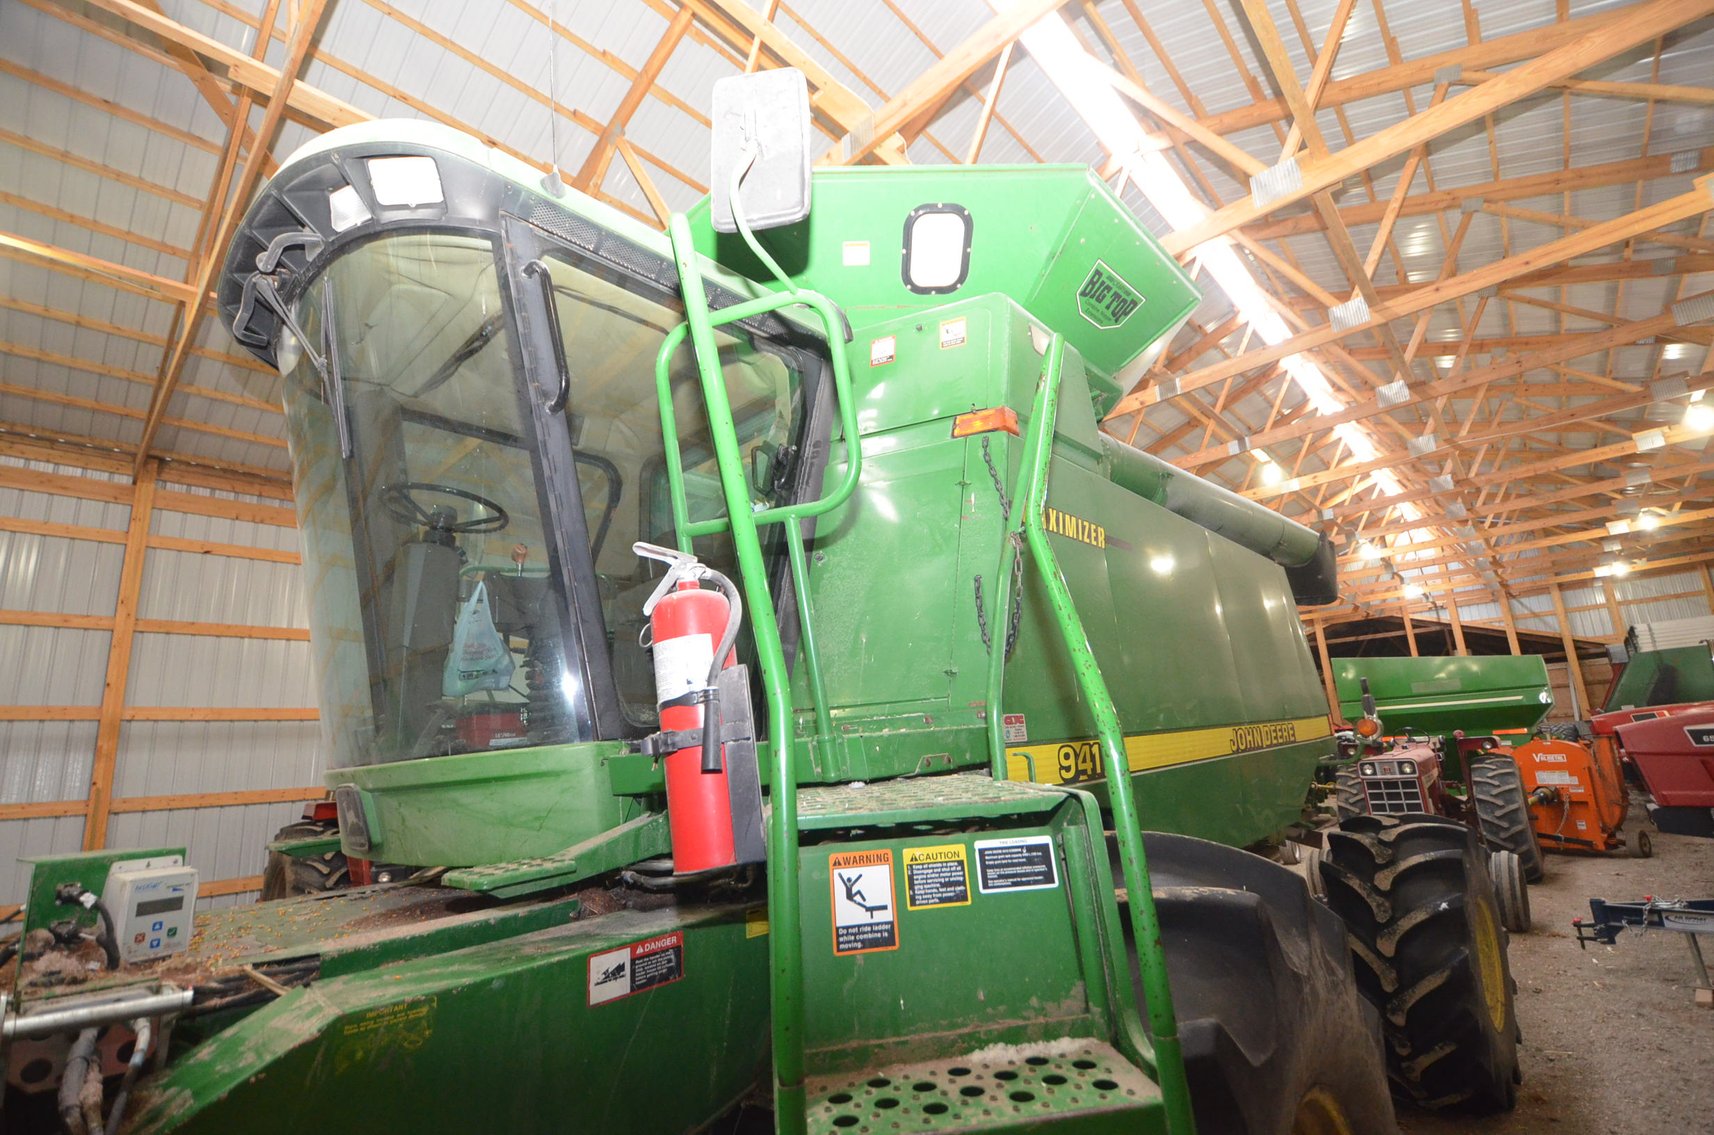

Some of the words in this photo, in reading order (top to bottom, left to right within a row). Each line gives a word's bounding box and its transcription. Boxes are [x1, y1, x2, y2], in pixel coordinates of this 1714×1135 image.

[1080, 269, 1113, 304] BIG
[1105, 290, 1138, 323] TOP
[1041, 506, 1106, 550] XIMIZER
[1230, 727, 1262, 752] JOHN
[1262, 722, 1296, 748] DEERE
[1058, 741, 1105, 784] 941
[842, 852, 889, 866] WARNING
[918, 851, 960, 862] CAUTION
[859, 925, 872, 933] ride
[873, 924, 891, 932] ladder
[644, 935, 677, 952] DANGER
[839, 934, 855, 942] while
[856, 932, 881, 941] combine
[839, 941, 863, 950] moving.
